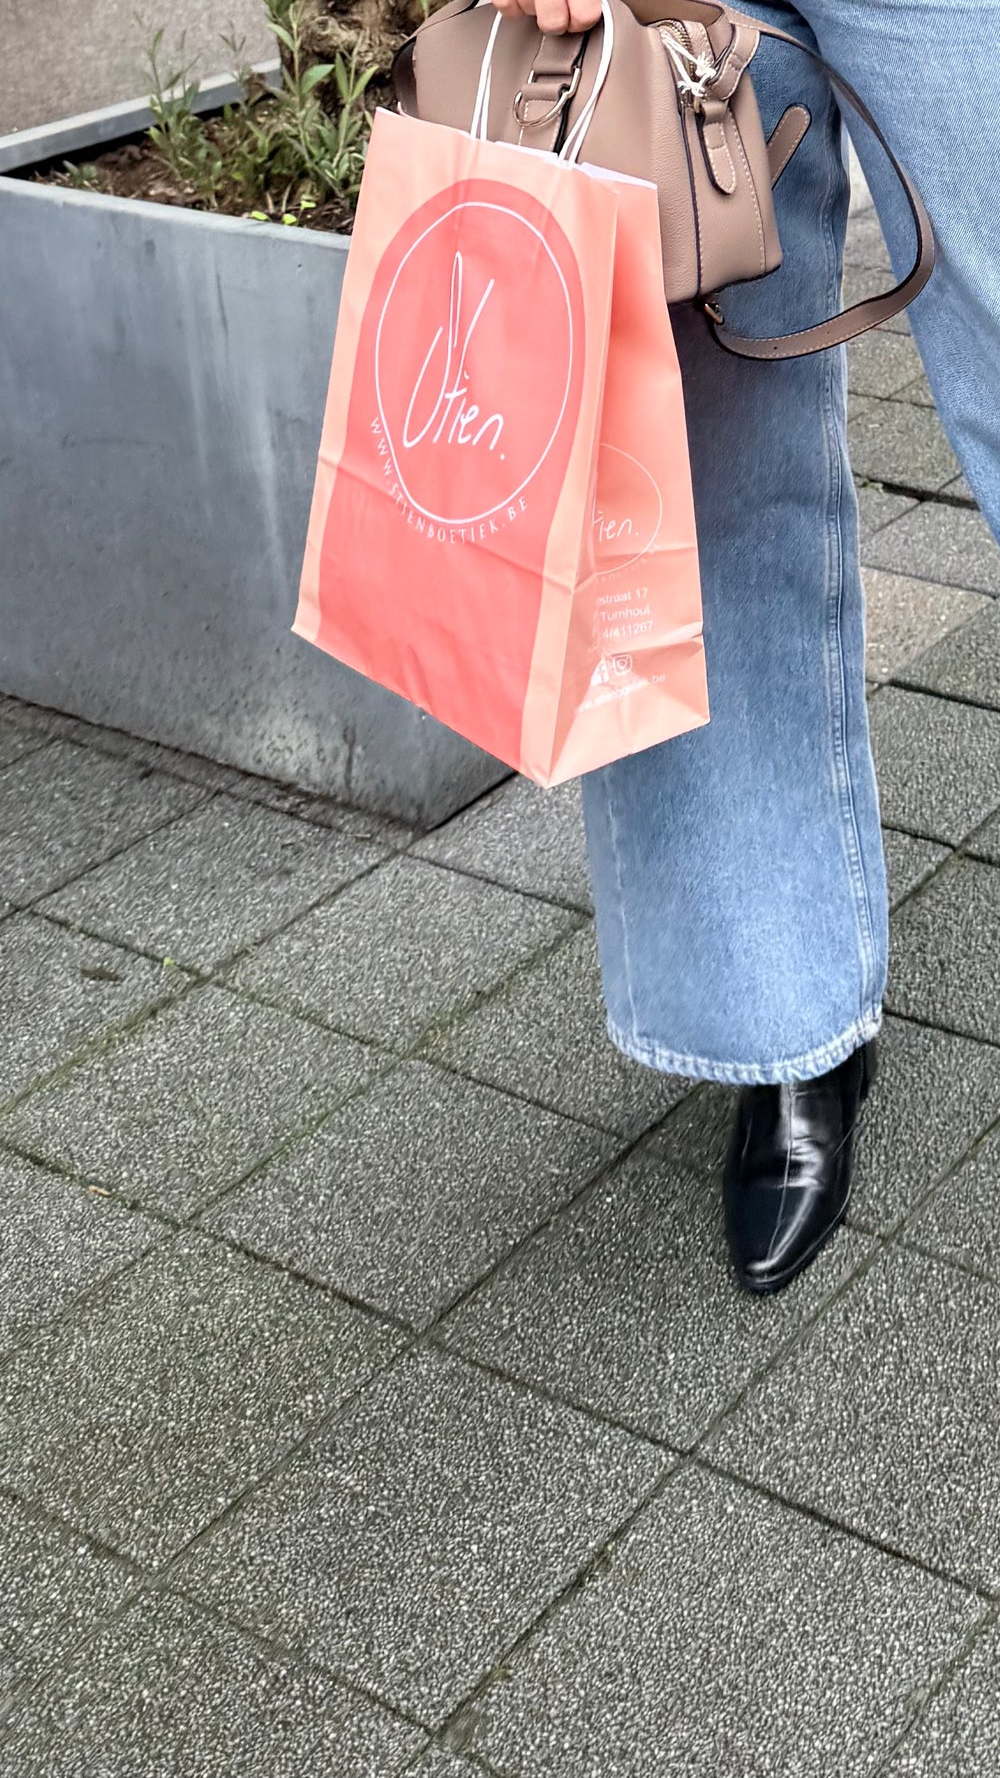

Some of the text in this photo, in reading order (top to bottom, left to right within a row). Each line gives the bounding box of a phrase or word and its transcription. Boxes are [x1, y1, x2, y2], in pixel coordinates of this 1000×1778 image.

[598, 586, 649, 607] straat 17
[600, 604, 652, 622] Turnhout
[602, 621, 654, 639] 4/411267
